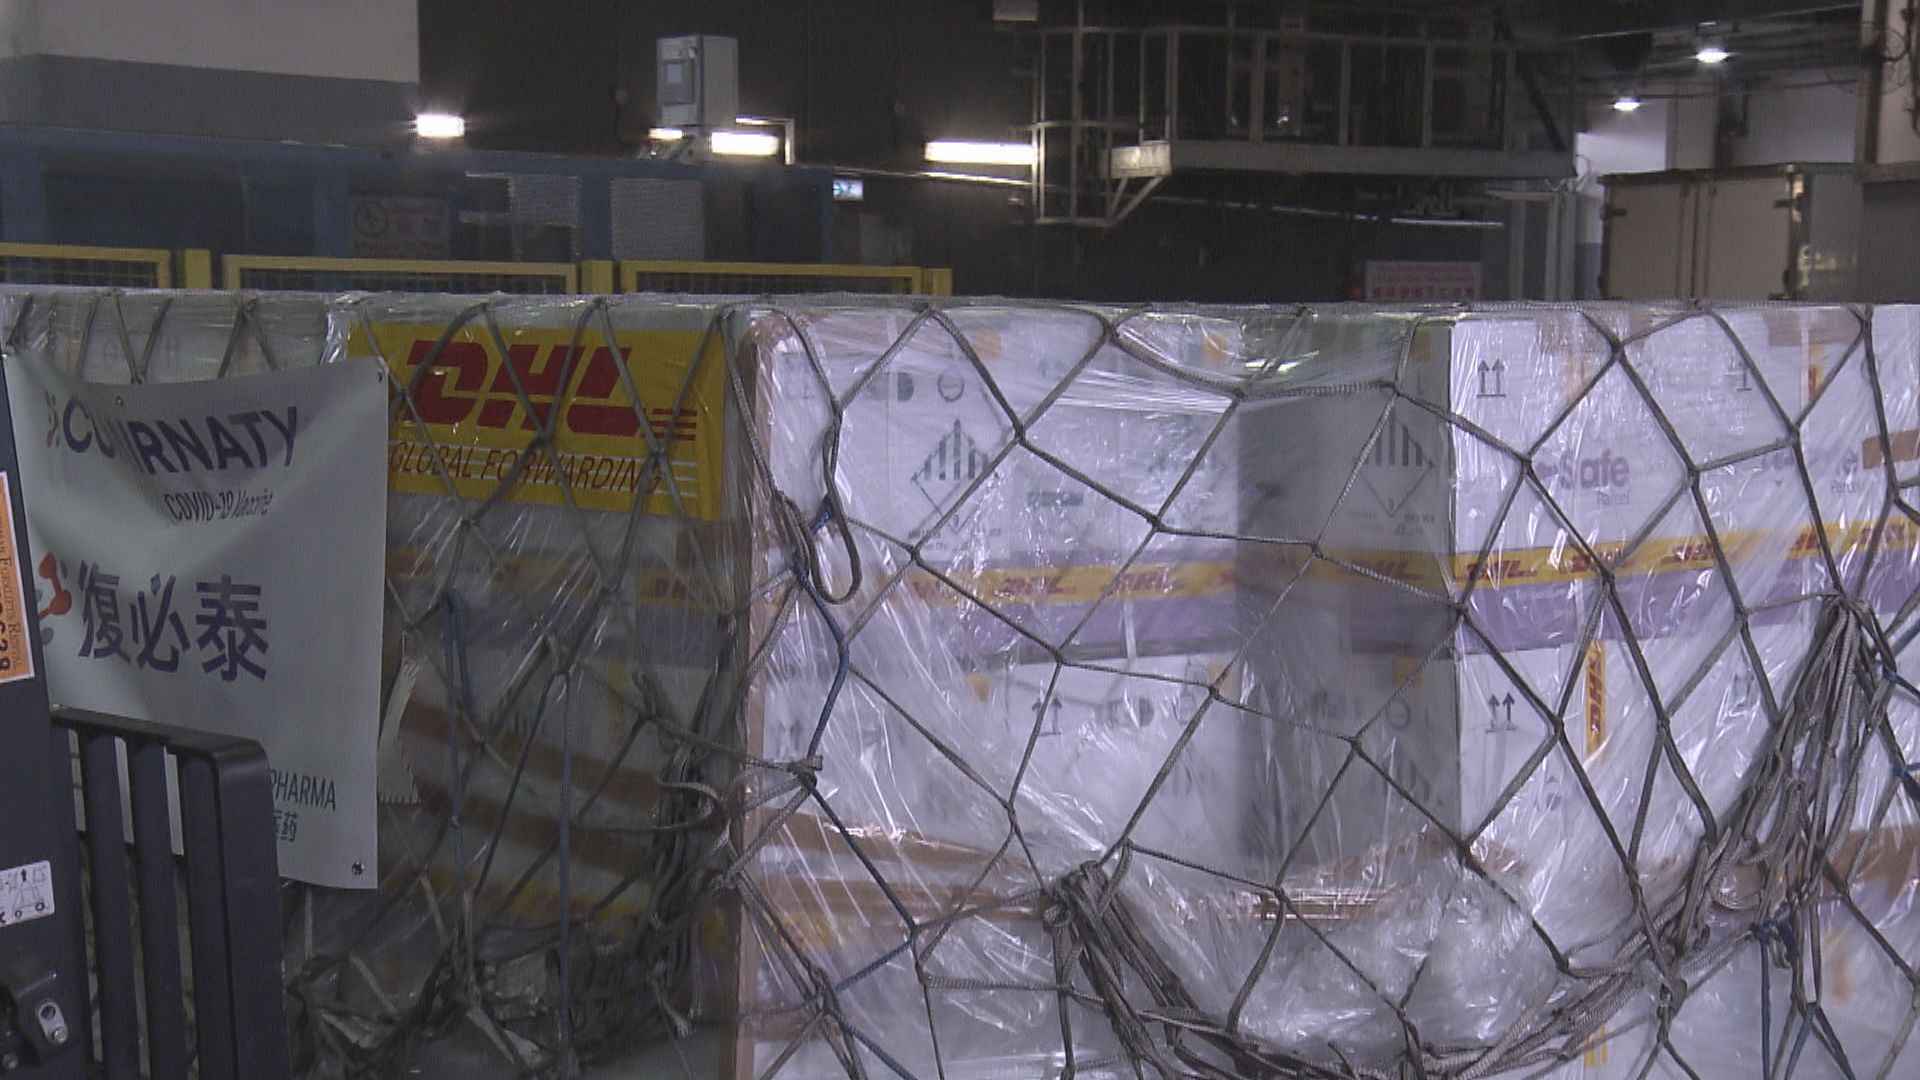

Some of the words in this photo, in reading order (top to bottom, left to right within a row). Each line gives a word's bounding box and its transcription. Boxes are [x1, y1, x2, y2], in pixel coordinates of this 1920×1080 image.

[404, 339, 646, 437] DHL
[62, 395, 298, 474] CORNATY
[388, 441, 476, 478] GLOBAL
[78, 559, 269, 682] 復必泰
